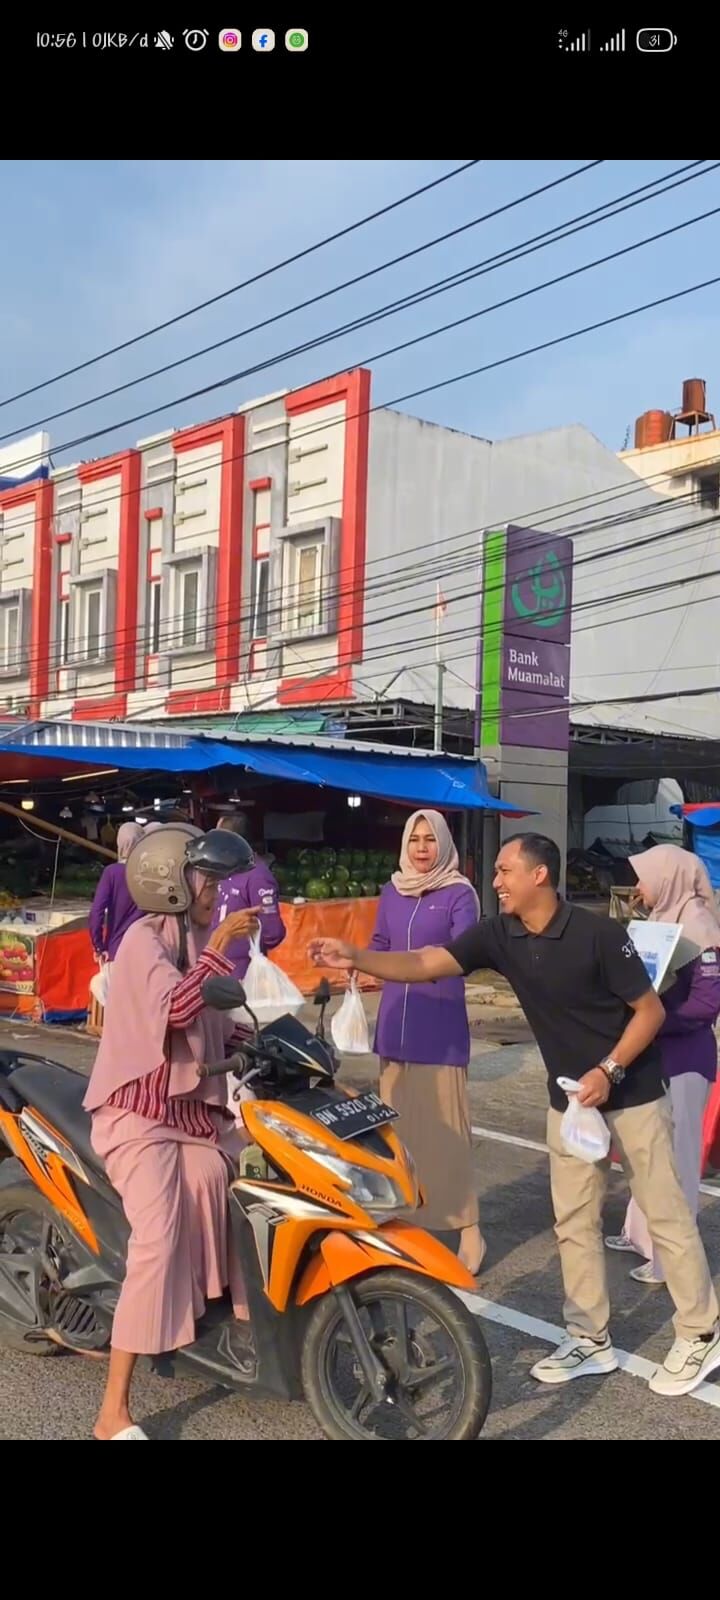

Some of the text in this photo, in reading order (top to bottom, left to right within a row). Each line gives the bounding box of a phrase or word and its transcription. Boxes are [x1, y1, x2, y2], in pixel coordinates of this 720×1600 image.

[508, 649, 539, 666] Bank
[507, 666, 566, 689] Muamalat
[337, 1098, 367, 1117] 5920
[301, 1183, 343, 1207] HONDA
